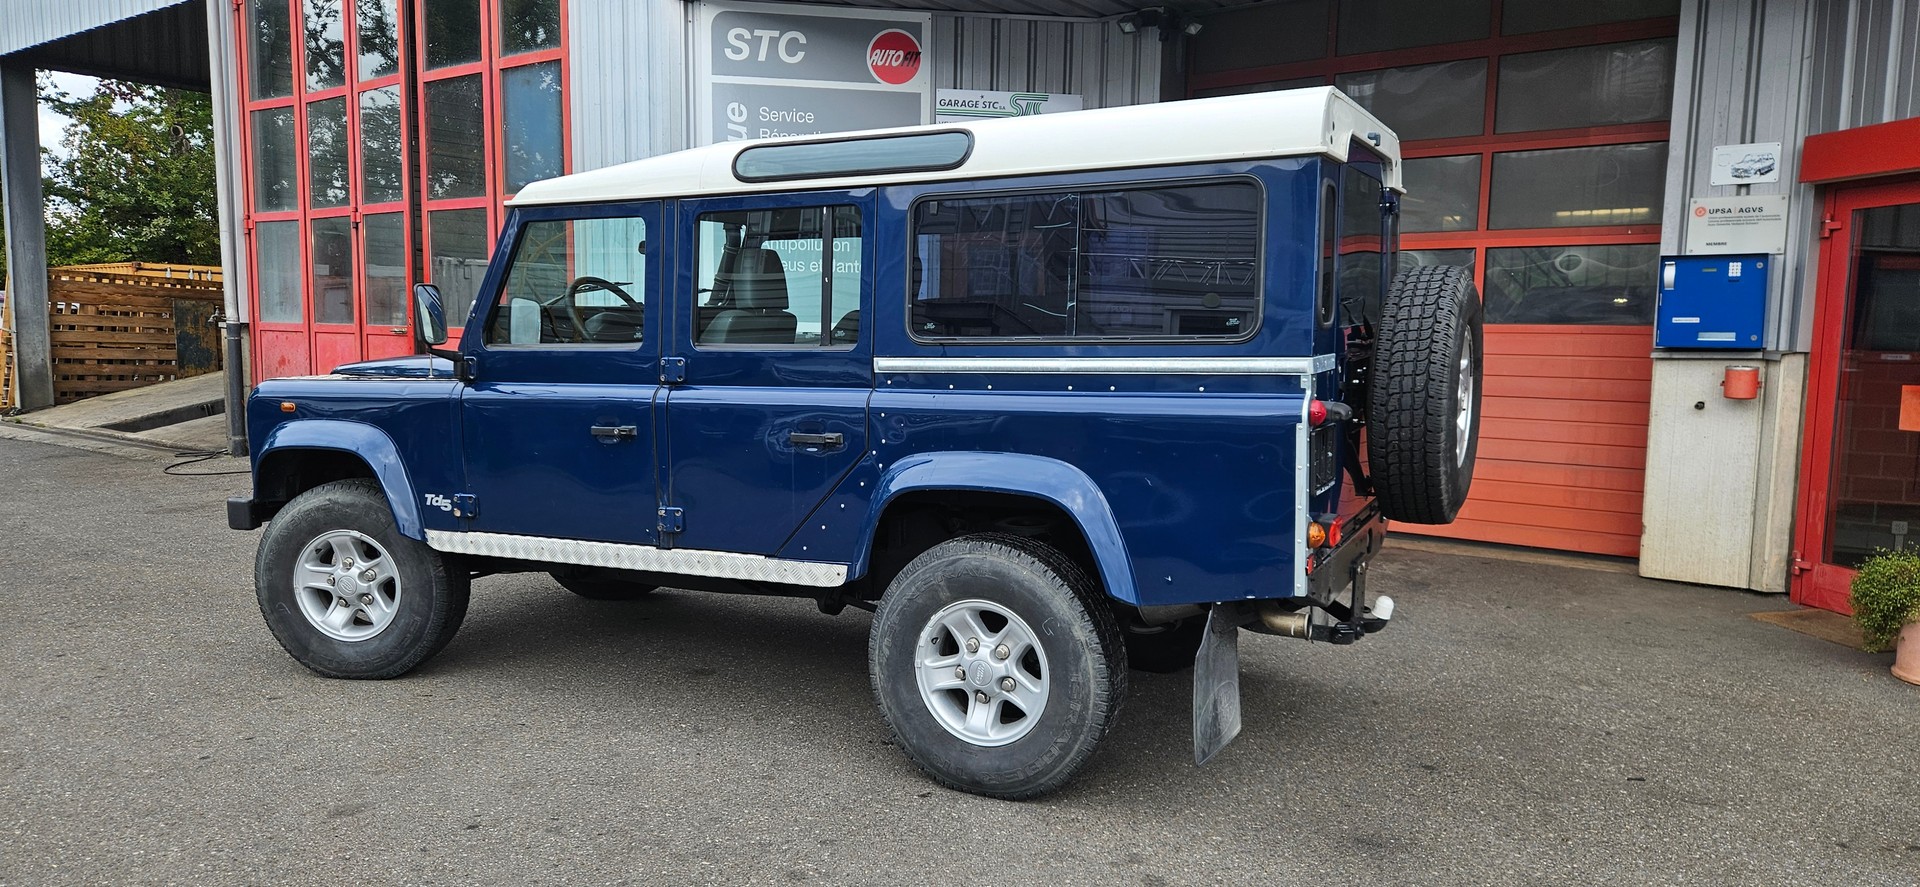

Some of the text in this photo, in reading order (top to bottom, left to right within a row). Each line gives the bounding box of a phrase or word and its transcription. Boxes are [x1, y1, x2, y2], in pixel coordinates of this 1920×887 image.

[724, 27, 807, 64] STC
[870, 48, 922, 68] AUTOFIT
[939, 98, 979, 109] GARAGE
[981, 100, 999, 110] STC
[759, 106, 814, 123] Service
[1708, 207, 1732, 215] UPSA
[425, 494, 452, 511] Td5
